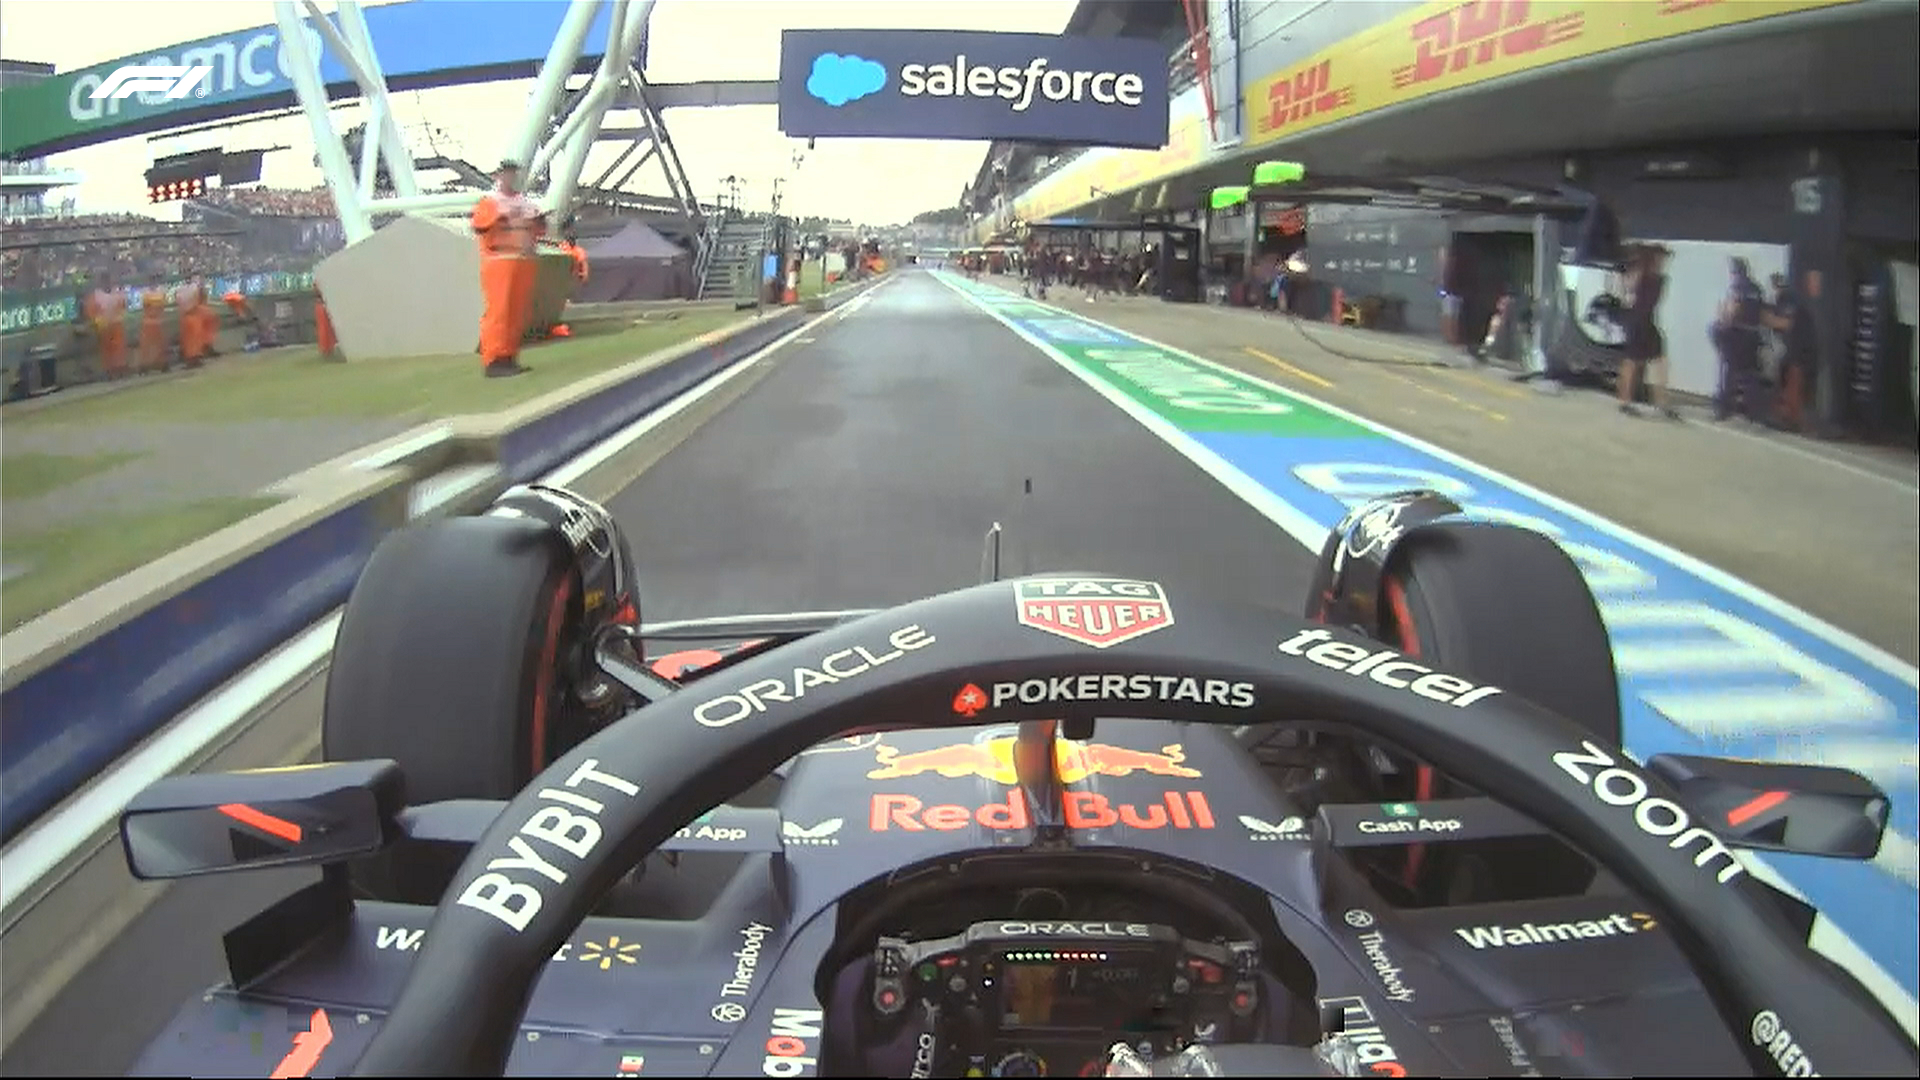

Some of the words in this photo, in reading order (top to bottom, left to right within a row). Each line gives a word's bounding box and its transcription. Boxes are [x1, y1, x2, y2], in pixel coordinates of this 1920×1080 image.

[900, 54, 1145, 112] salesforce
[1260, 59, 1350, 134] DHL
[1029, 580, 1152, 596] TAG
[1026, 603, 1162, 636] HEUER
[692, 623, 936, 728] ORACLE
[992, 673, 1256, 708] POKERSTARS
[869, 786, 1030, 832] Red
[1061, 790, 1216, 830] Bull
[1358, 819, 1414, 834] Cash
[1418, 818, 1462, 833] App
[1552, 740, 1743, 884] zoom
[456, 758, 641, 932] BYBIT
[1000, 922, 1150, 937] ORACLE
[1455, 913, 1638, 950] Walmart
[720, 920, 774, 998] Therabody
